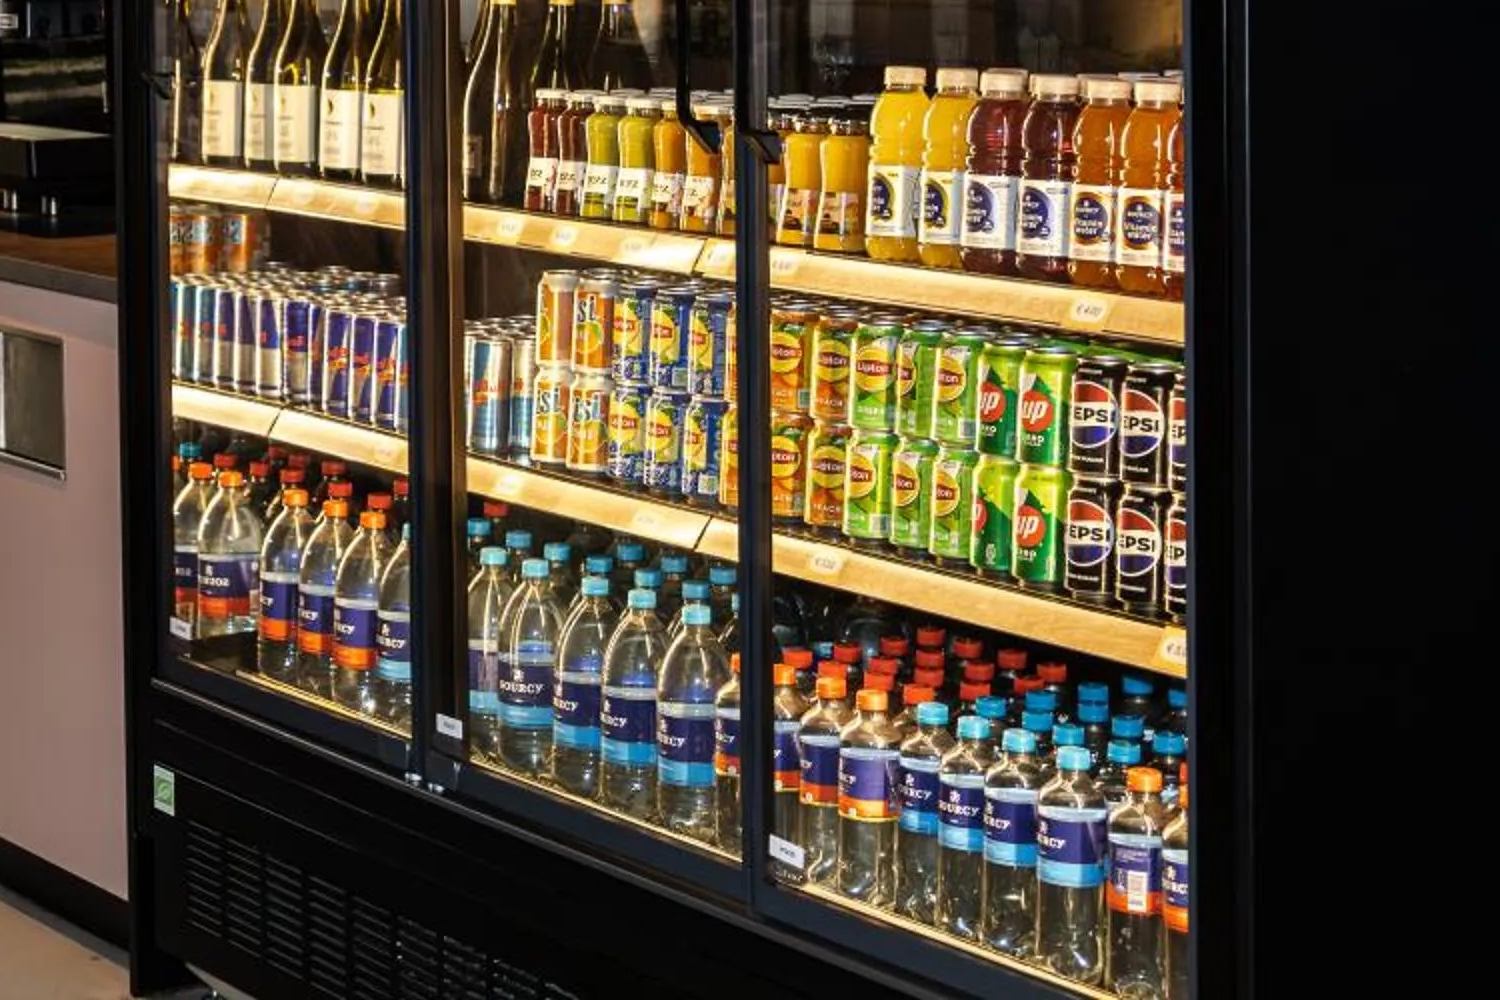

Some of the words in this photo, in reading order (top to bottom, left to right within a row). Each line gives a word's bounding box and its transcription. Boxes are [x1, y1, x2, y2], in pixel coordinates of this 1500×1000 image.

[857, 361, 889, 374] Lipton
[1074, 407, 1117, 422] EPSI
[1124, 416, 1160, 433] EPSI
[1070, 525, 1110, 542] EPSI
[1119, 535, 1155, 553] EPSI
[500, 680, 543, 695] SOURCY
